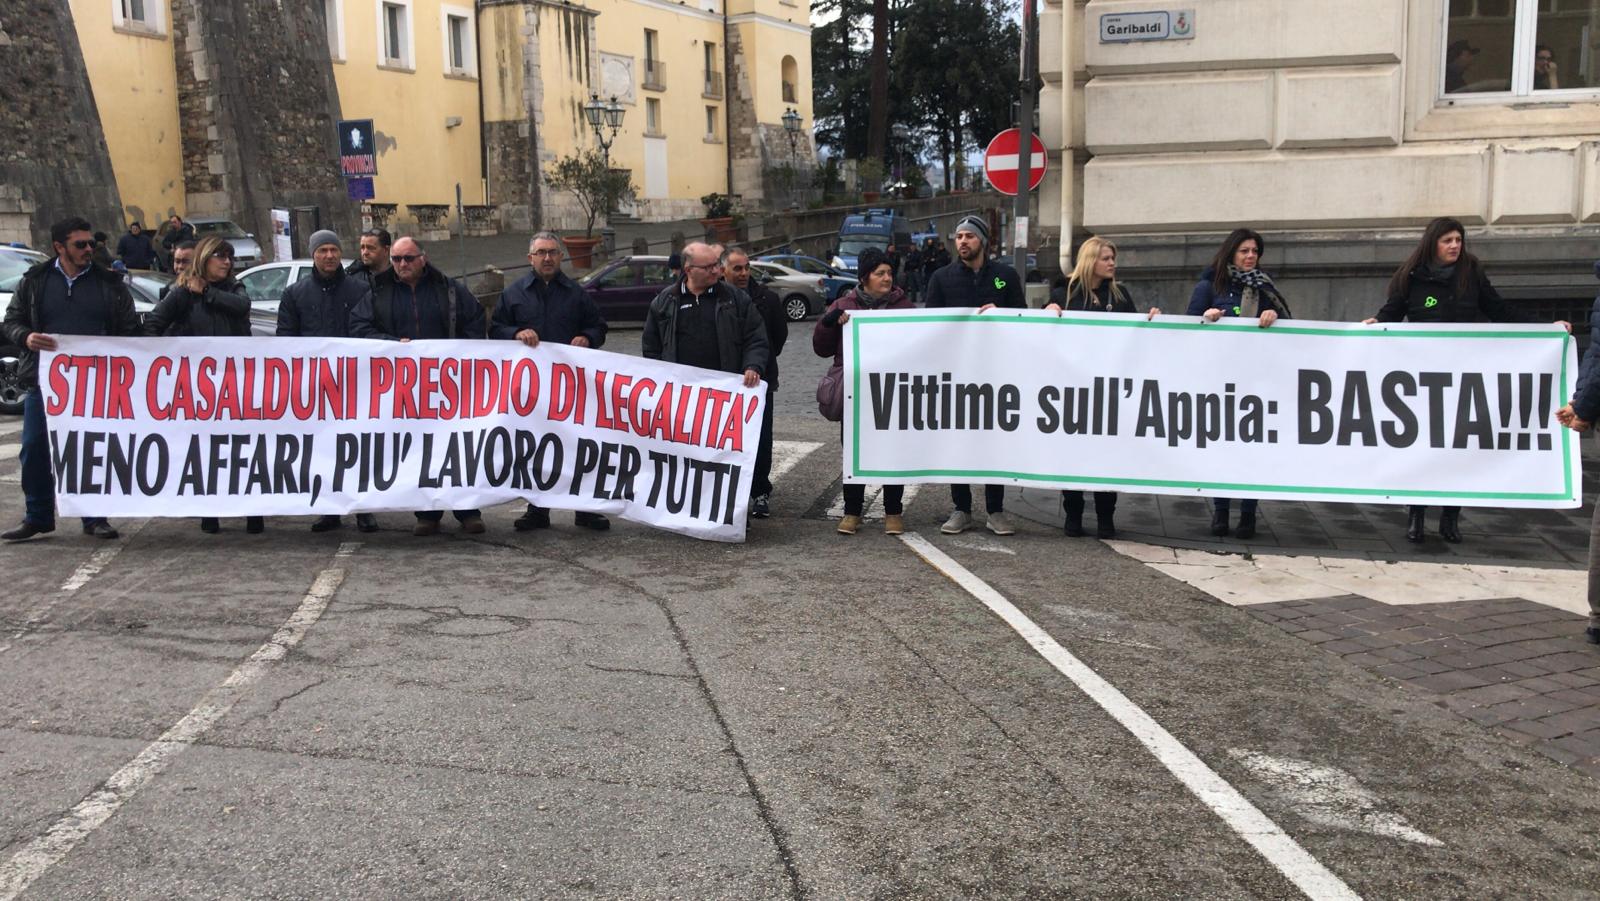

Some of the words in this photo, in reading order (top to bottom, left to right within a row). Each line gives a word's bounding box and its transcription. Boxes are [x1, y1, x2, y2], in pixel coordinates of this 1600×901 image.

[1107, 23, 1161, 35] Garibaldi
[341, 154, 375, 175] PROVINCIA
[47, 353, 136, 421] STIR
[146, 356, 358, 421] CASALDUNI
[368, 356, 540, 420] PRESIDIO
[547, 362, 586, 425] DI
[595, 369, 759, 452] LEGALITA'
[869, 372, 1021, 432] Vittime
[1036, 376, 1279, 449] sull'Appia:
[1298, 368, 1553, 451] BASTA!!!
[50, 430, 170, 496] MENO
[177, 432, 322, 507] AFFARI,
[332, 431, 413, 493] PIU'
[418, 426, 564, 492] LAVORO
[569, 437, 642, 502] PER
[646, 449, 742, 526] TUTTI
